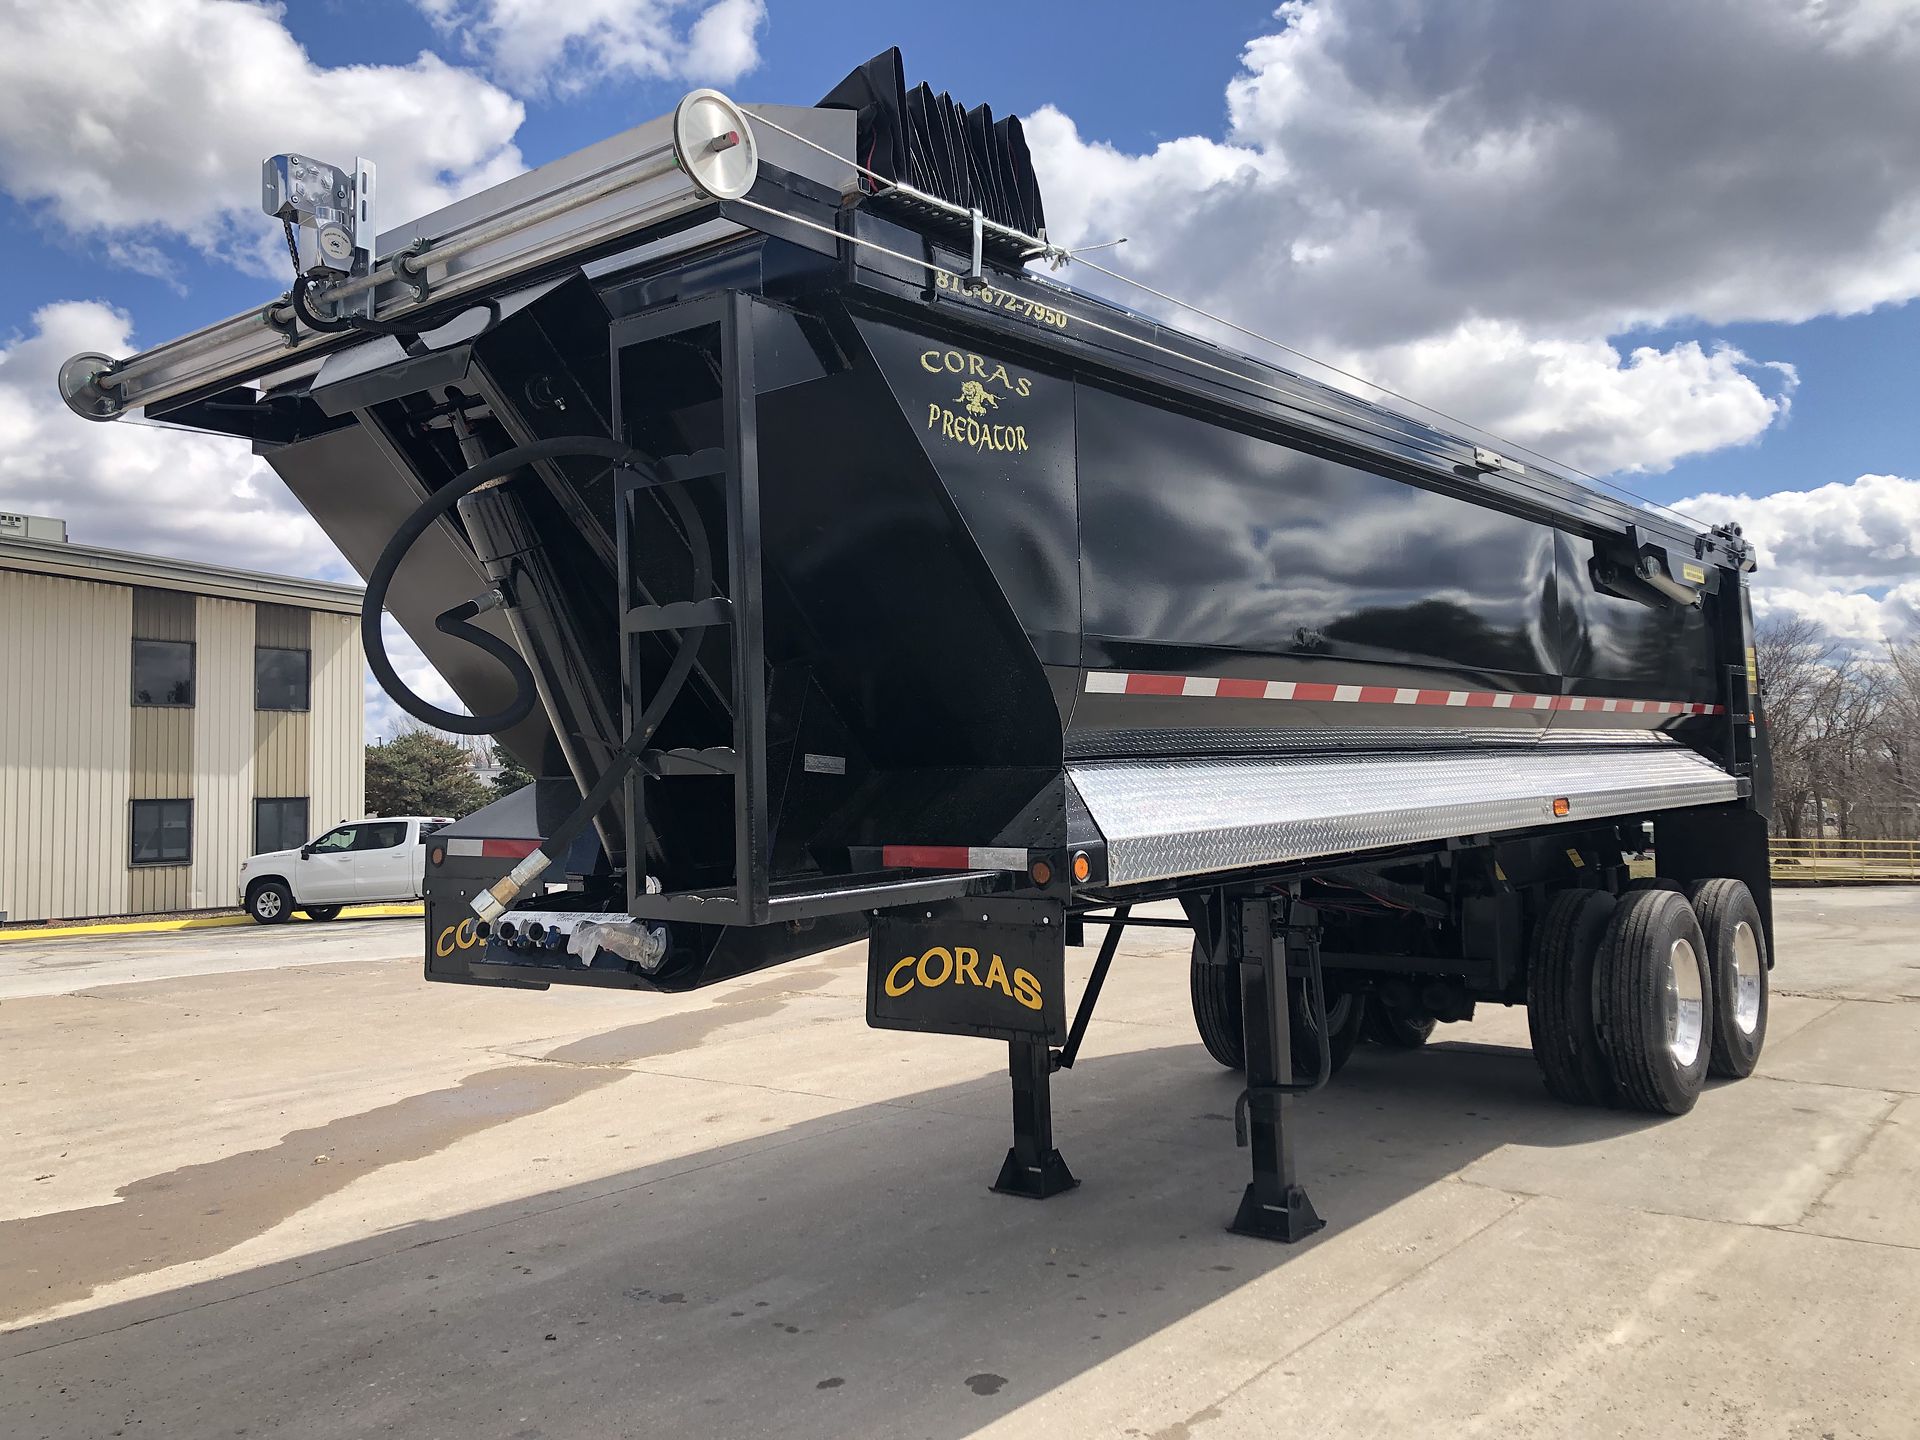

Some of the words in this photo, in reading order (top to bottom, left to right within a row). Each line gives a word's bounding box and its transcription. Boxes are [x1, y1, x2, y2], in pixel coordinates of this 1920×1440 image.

[920, 350, 1033, 397] CORAS
[928, 403, 1029, 454] PREDATOR
[884, 946, 1044, 1010] CORAS
